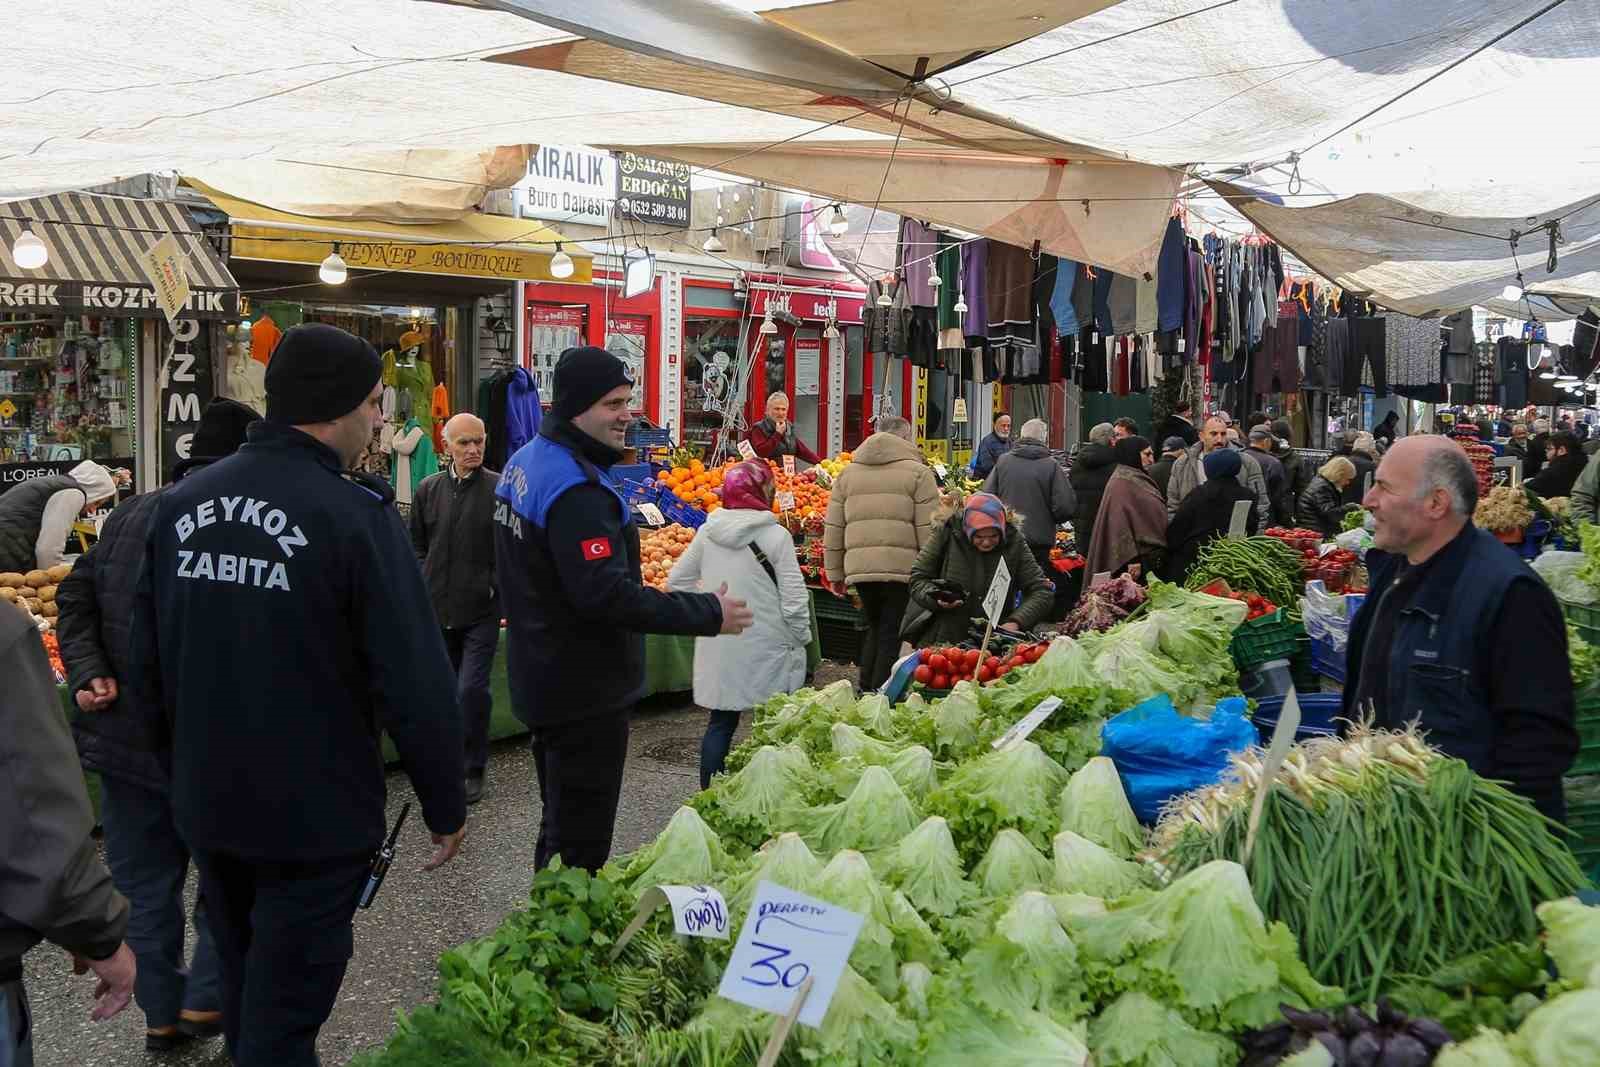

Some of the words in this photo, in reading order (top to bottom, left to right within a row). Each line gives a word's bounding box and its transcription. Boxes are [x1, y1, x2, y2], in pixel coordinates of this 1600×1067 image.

[636, 155, 675, 178] SALON
[621, 176, 688, 201] ERDOĞAN
[630, 199, 650, 216] 0532
[431, 250, 523, 273] BOUTIQUE
[174, 495, 309, 559] BEYKOZ
[177, 550, 291, 592] ZABITA
[741, 941, 810, 988] 30
